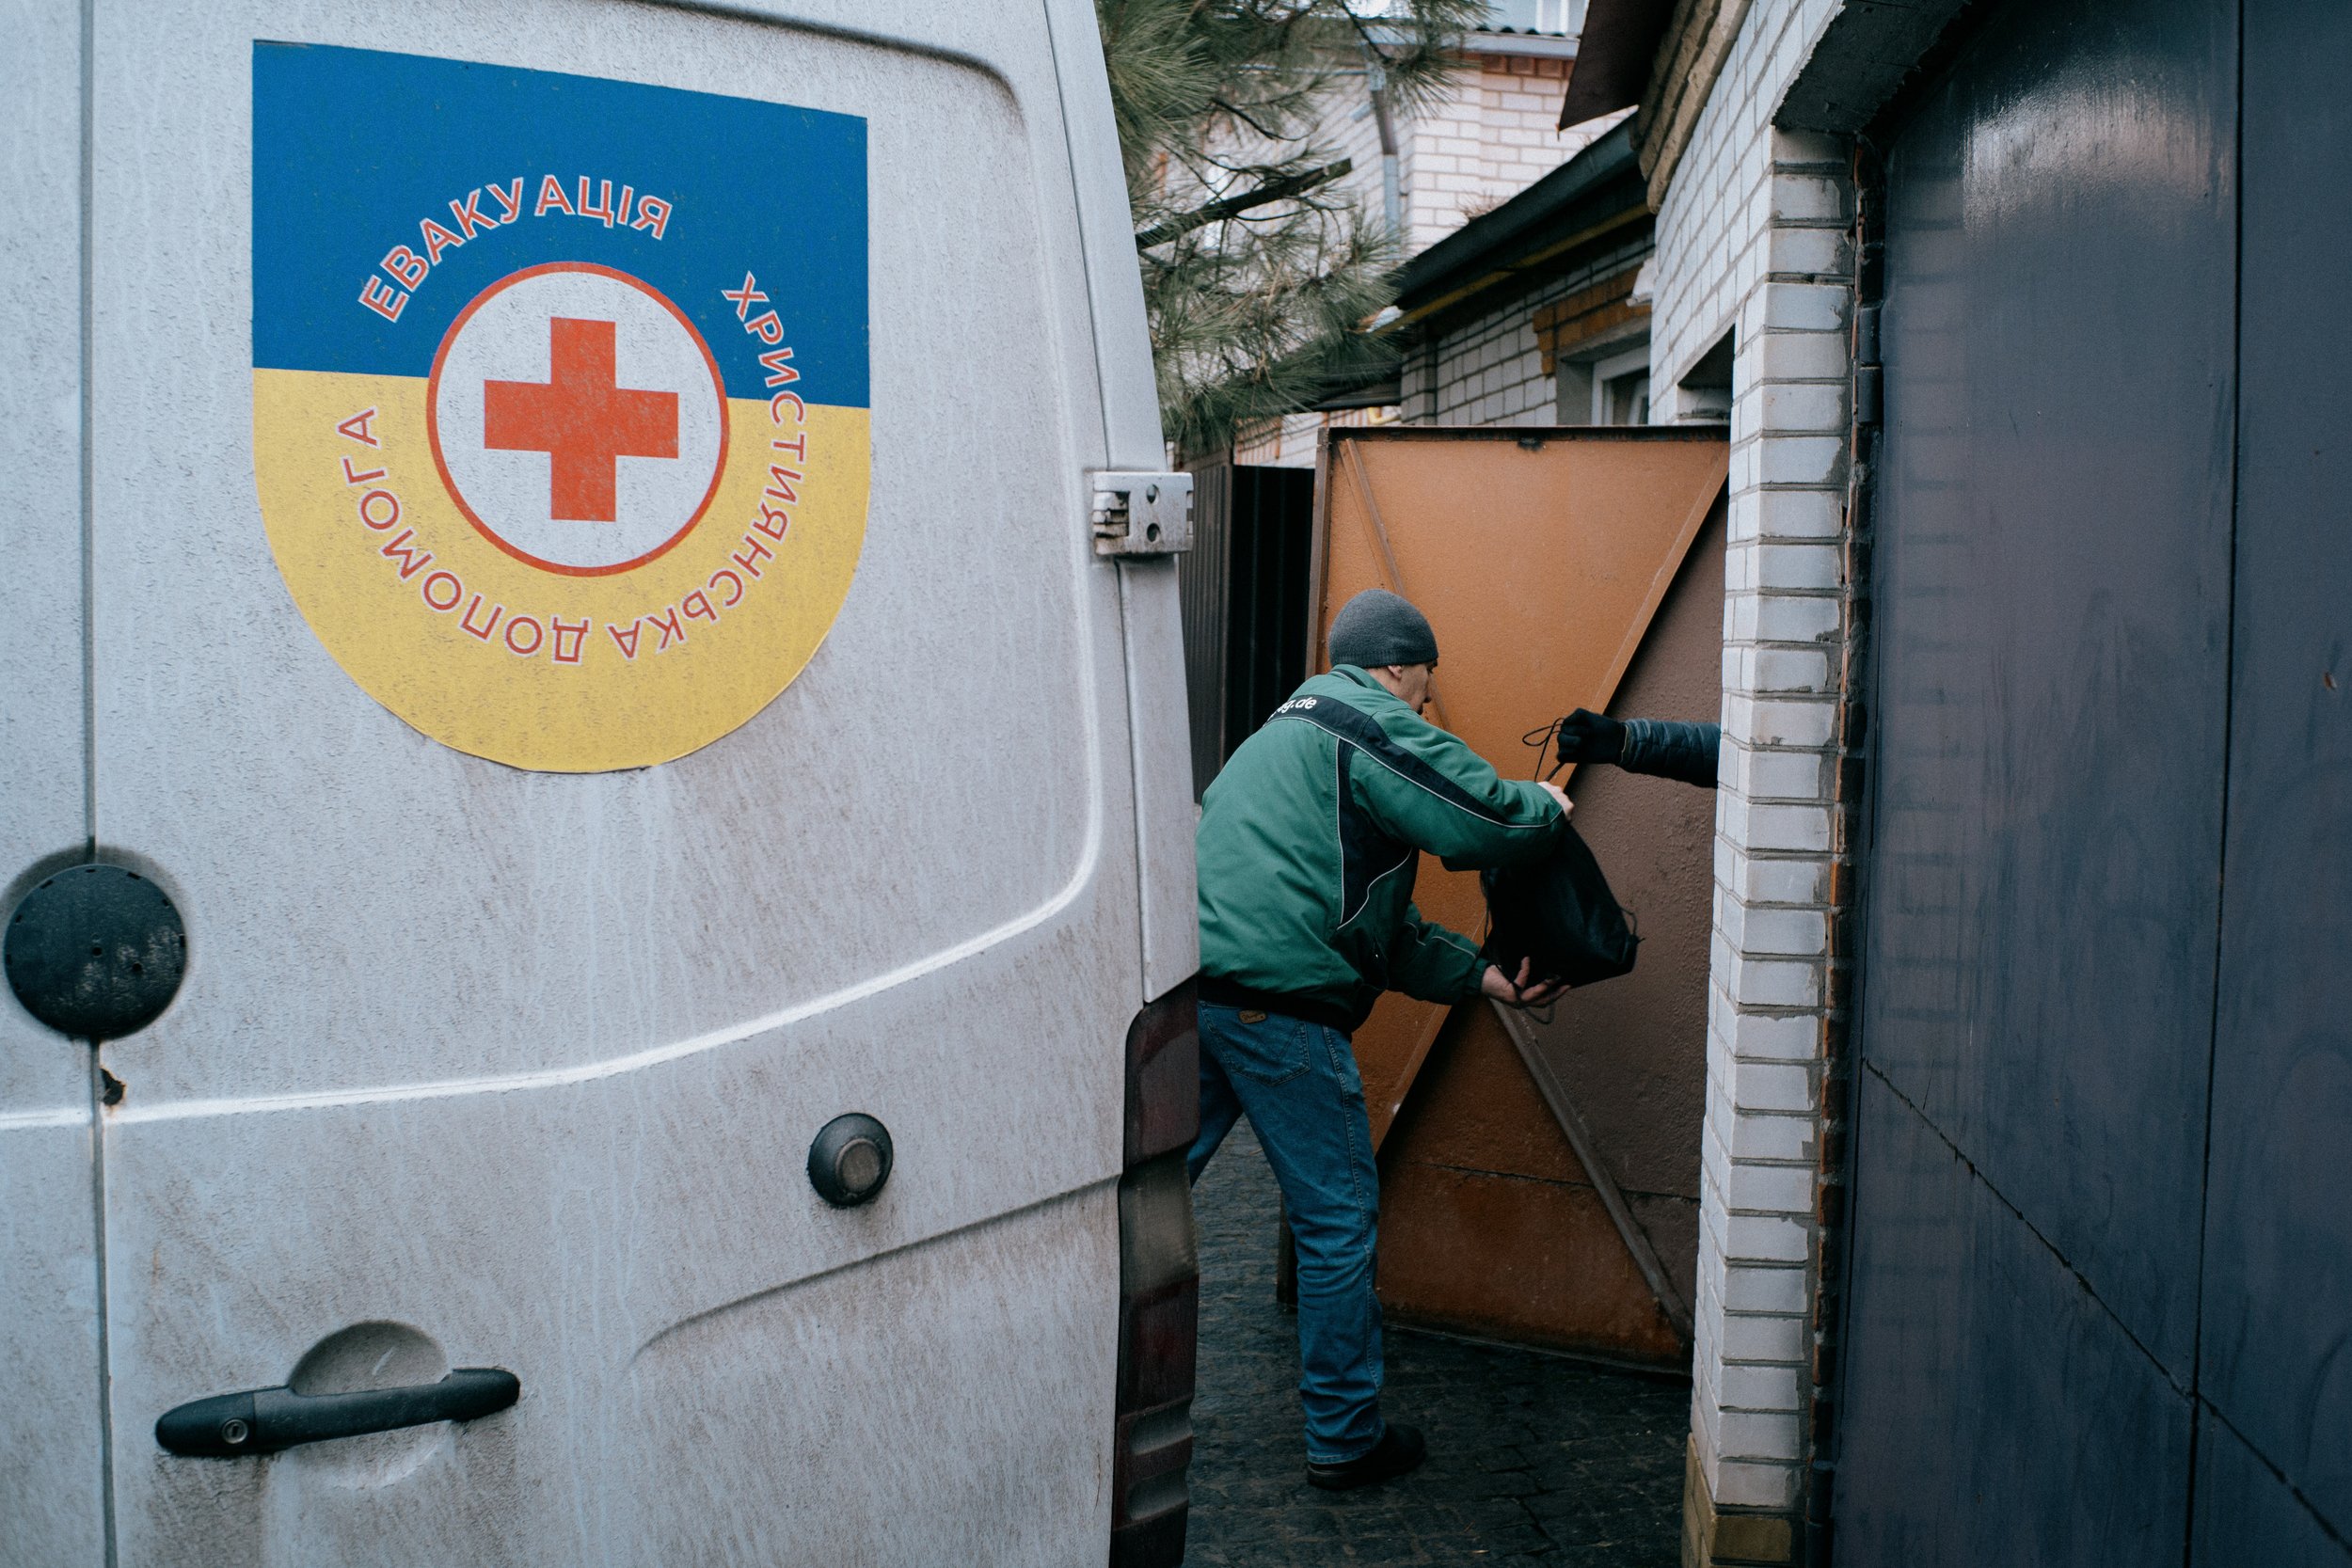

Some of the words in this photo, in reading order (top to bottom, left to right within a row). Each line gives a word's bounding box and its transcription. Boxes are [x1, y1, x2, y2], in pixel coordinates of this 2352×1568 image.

[358, 173, 674, 324] ЕВАКУАЦІЯ
[336, 404, 591, 666] ДОПОМОГА
[606, 270, 807, 661] ХРИСТИЯНСЬКА
[1275, 697, 1317, 714] g.de
